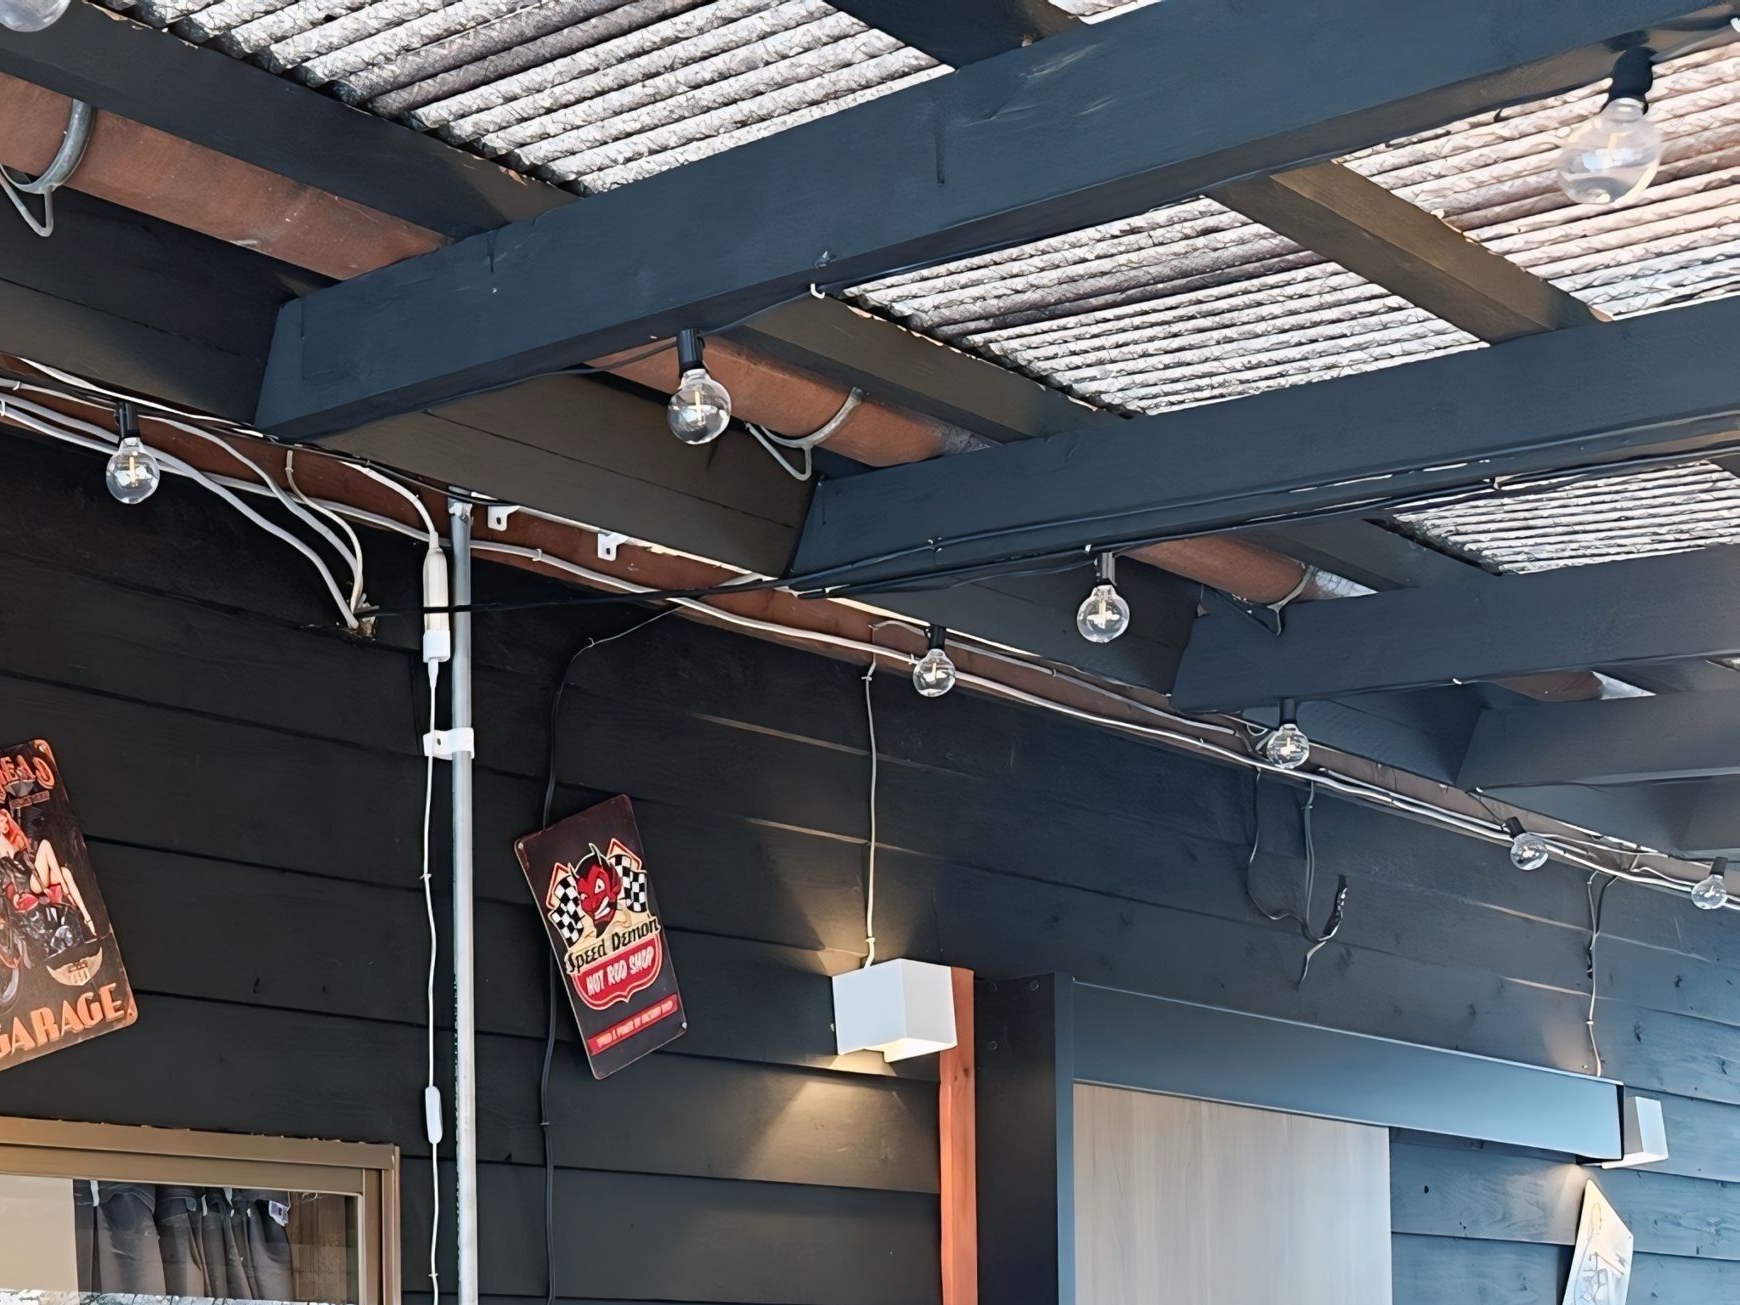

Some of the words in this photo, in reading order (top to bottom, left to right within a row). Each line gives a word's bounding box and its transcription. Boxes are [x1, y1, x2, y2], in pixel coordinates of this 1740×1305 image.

[585, 968, 605, 997] HOT
[606, 959, 628, 986] ROD
[628, 945, 655, 975] SHOP
